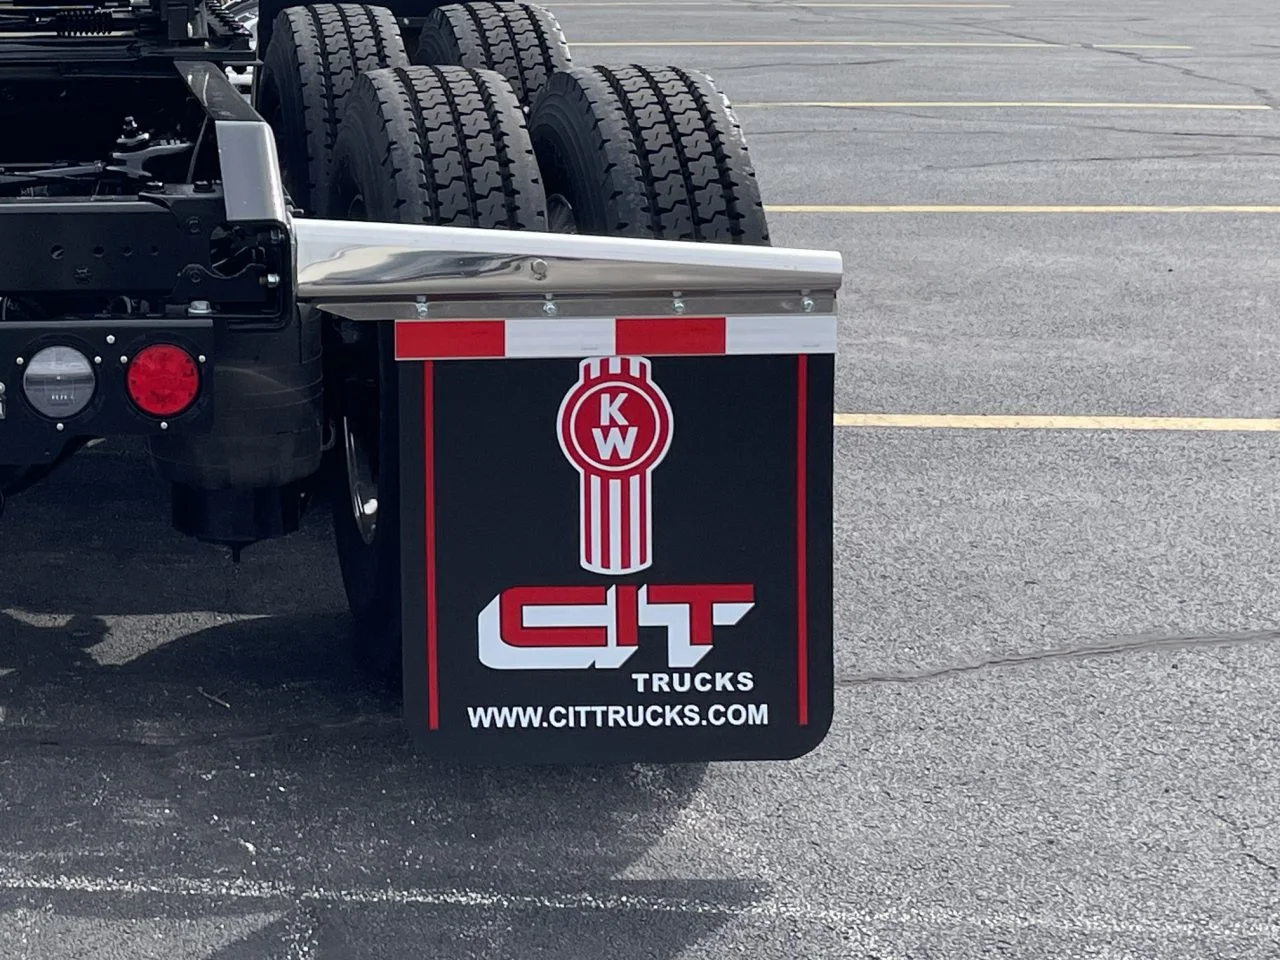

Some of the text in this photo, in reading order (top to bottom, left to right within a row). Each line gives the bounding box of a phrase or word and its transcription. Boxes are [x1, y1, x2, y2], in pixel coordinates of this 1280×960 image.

[600, 393, 629, 426] K
[591, 426, 638, 460] W
[478, 584, 755, 669] CIT
[632, 672, 754, 693] TRUCKS
[467, 704, 769, 729] WWW.CITTRUCKS.COM
